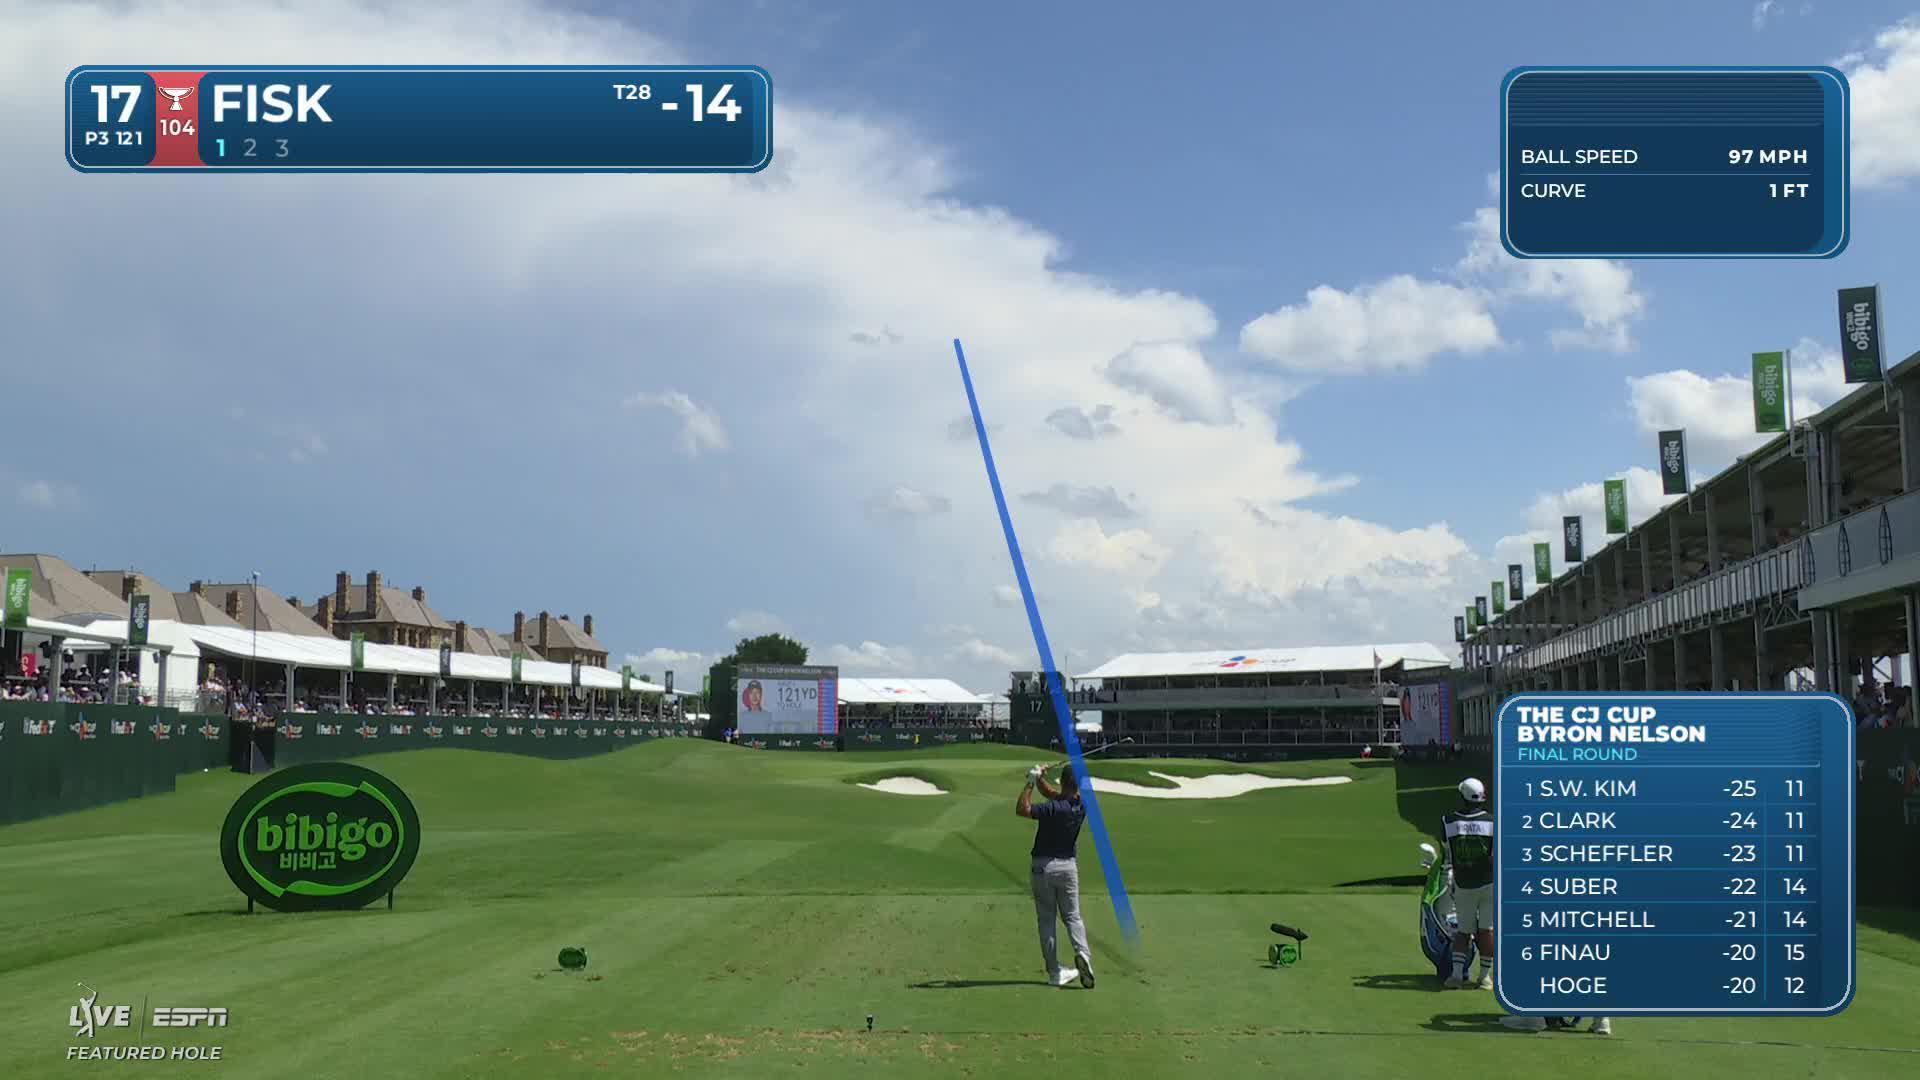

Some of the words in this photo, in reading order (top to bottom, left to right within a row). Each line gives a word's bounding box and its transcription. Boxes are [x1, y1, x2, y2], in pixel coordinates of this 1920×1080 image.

[1850, 302, 1872, 350] bibigo
[1761, 364, 1779, 405] bibigo
[1667, 440, 1680, 473] bibigo
[1030, 700, 1043, 713] 17
[256, 811, 394, 862] bibigo
[279, 851, 337, 872] 비비고
